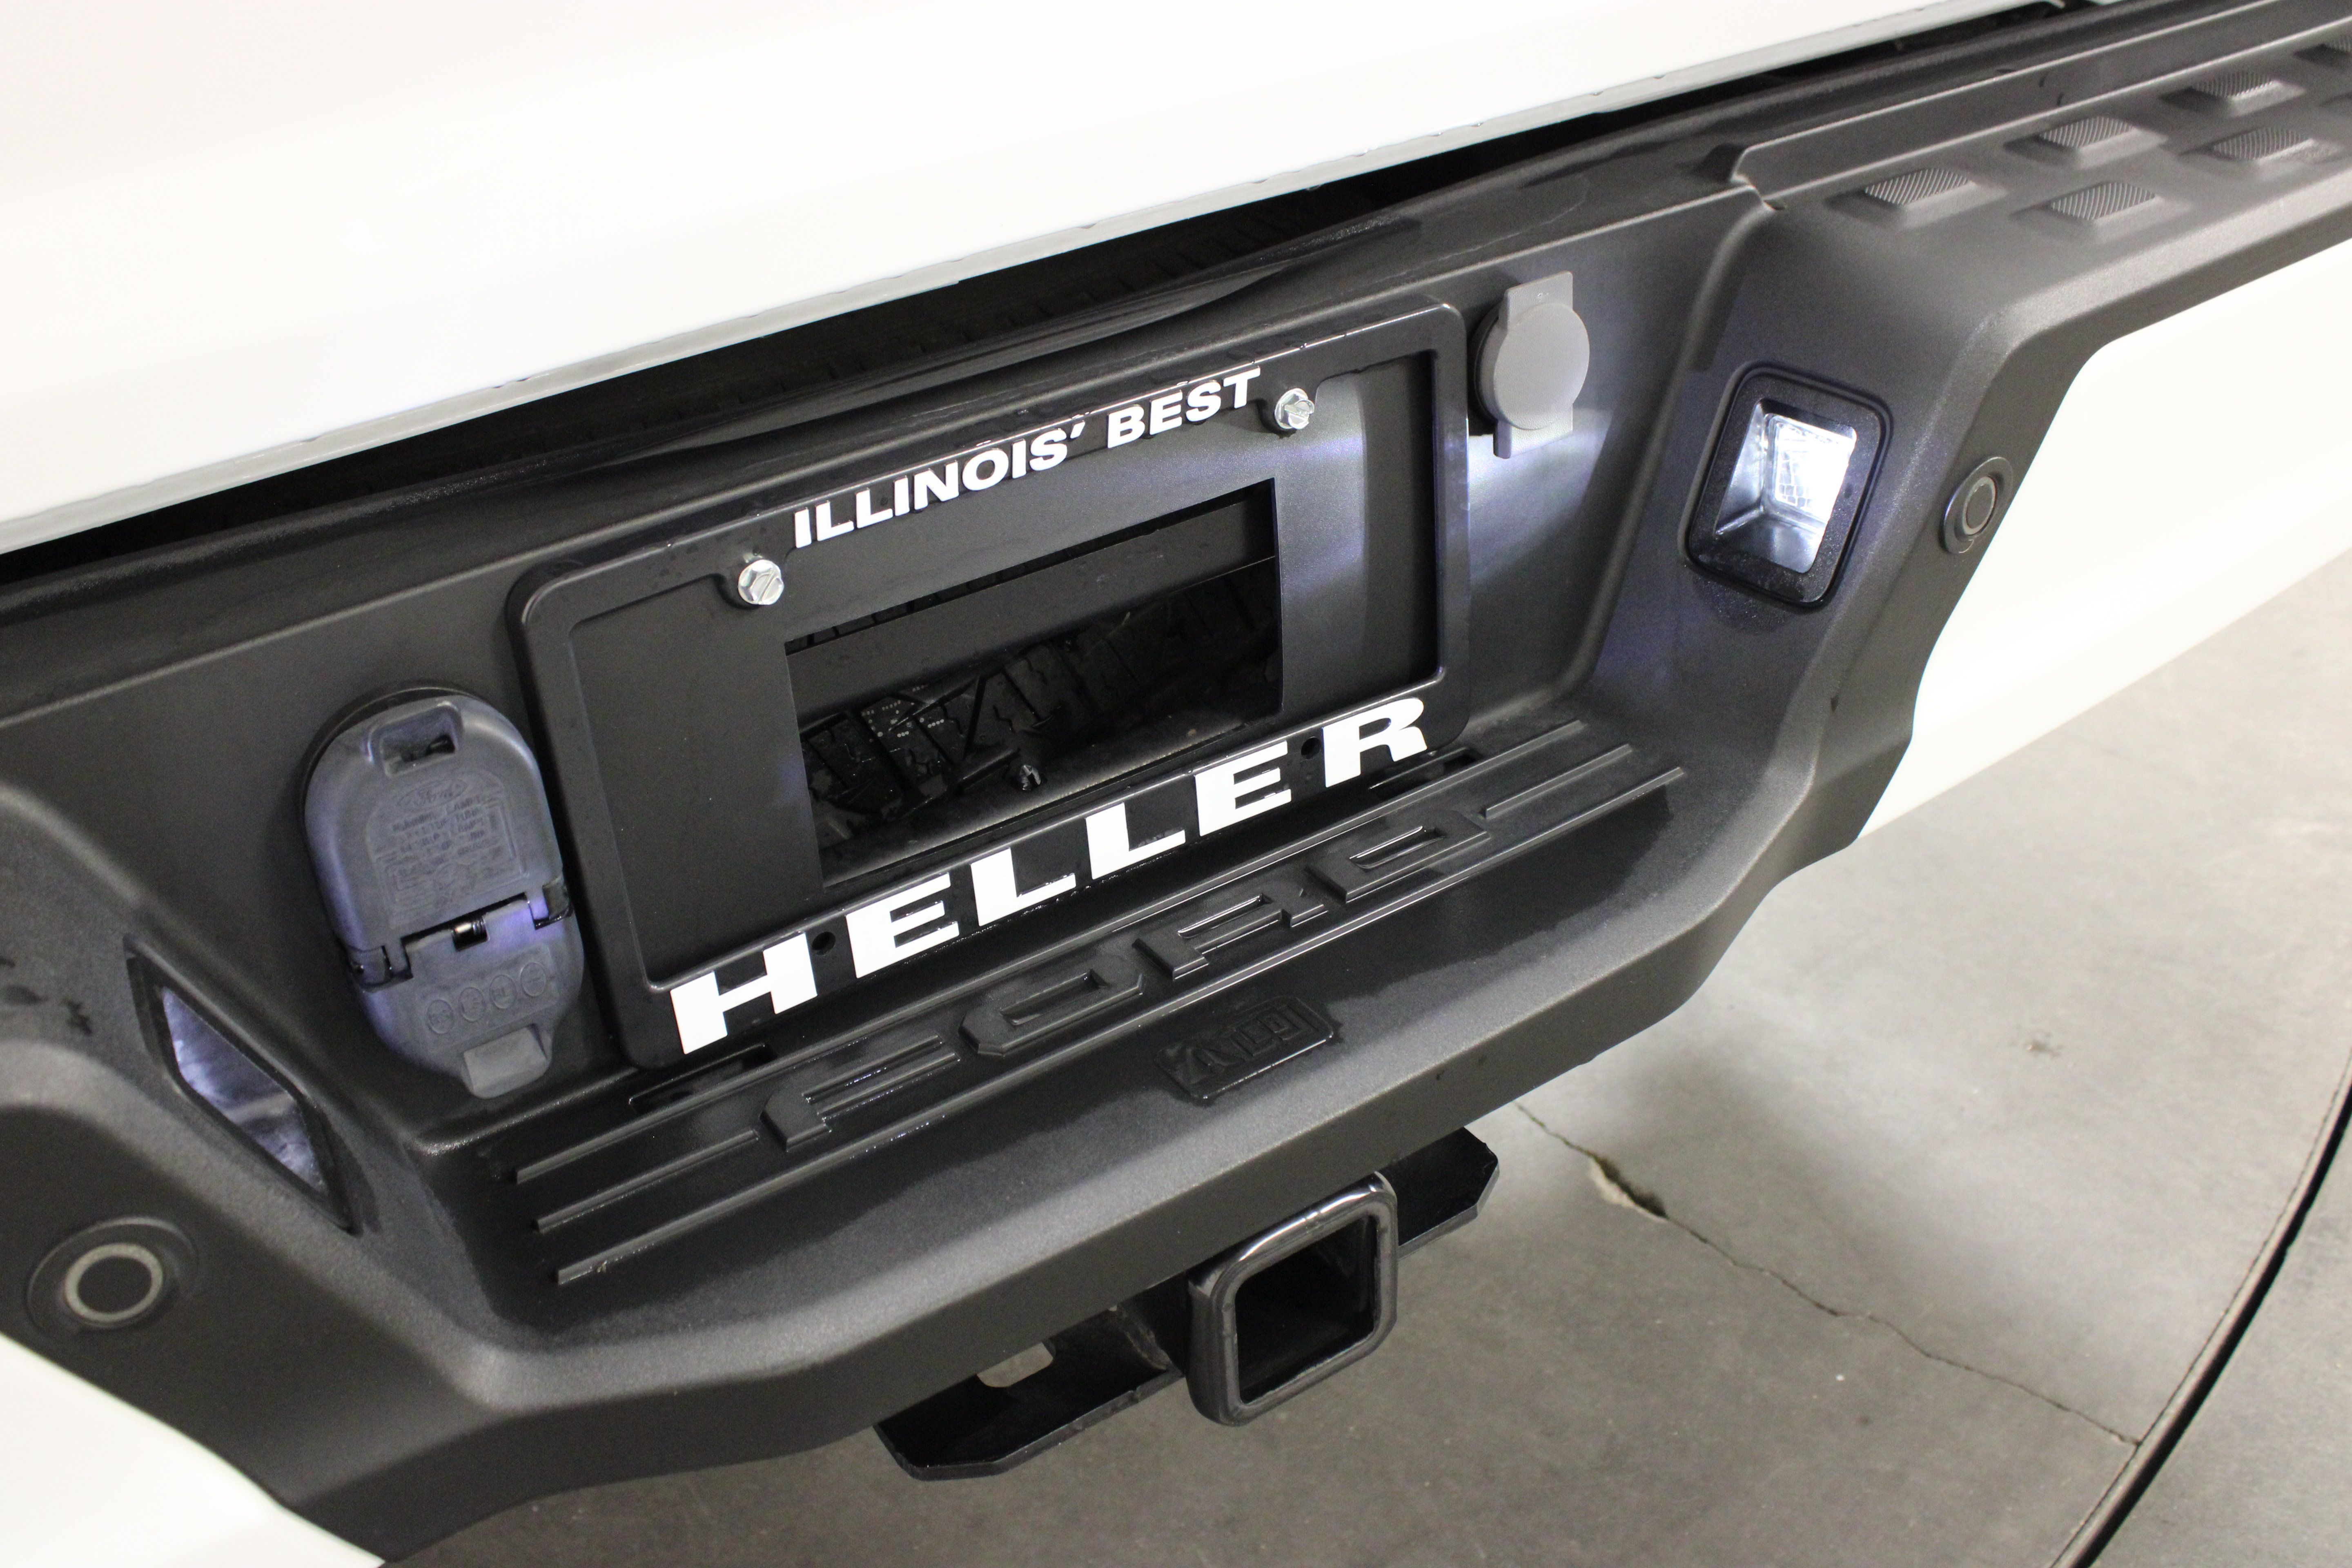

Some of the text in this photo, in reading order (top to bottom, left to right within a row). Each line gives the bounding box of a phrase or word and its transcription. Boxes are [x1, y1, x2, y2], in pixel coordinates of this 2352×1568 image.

[1107, 366, 1261, 449] BEST
[669, 696, 1428, 1054] HELLER
[759, 809, 1491, 1151] FORD
